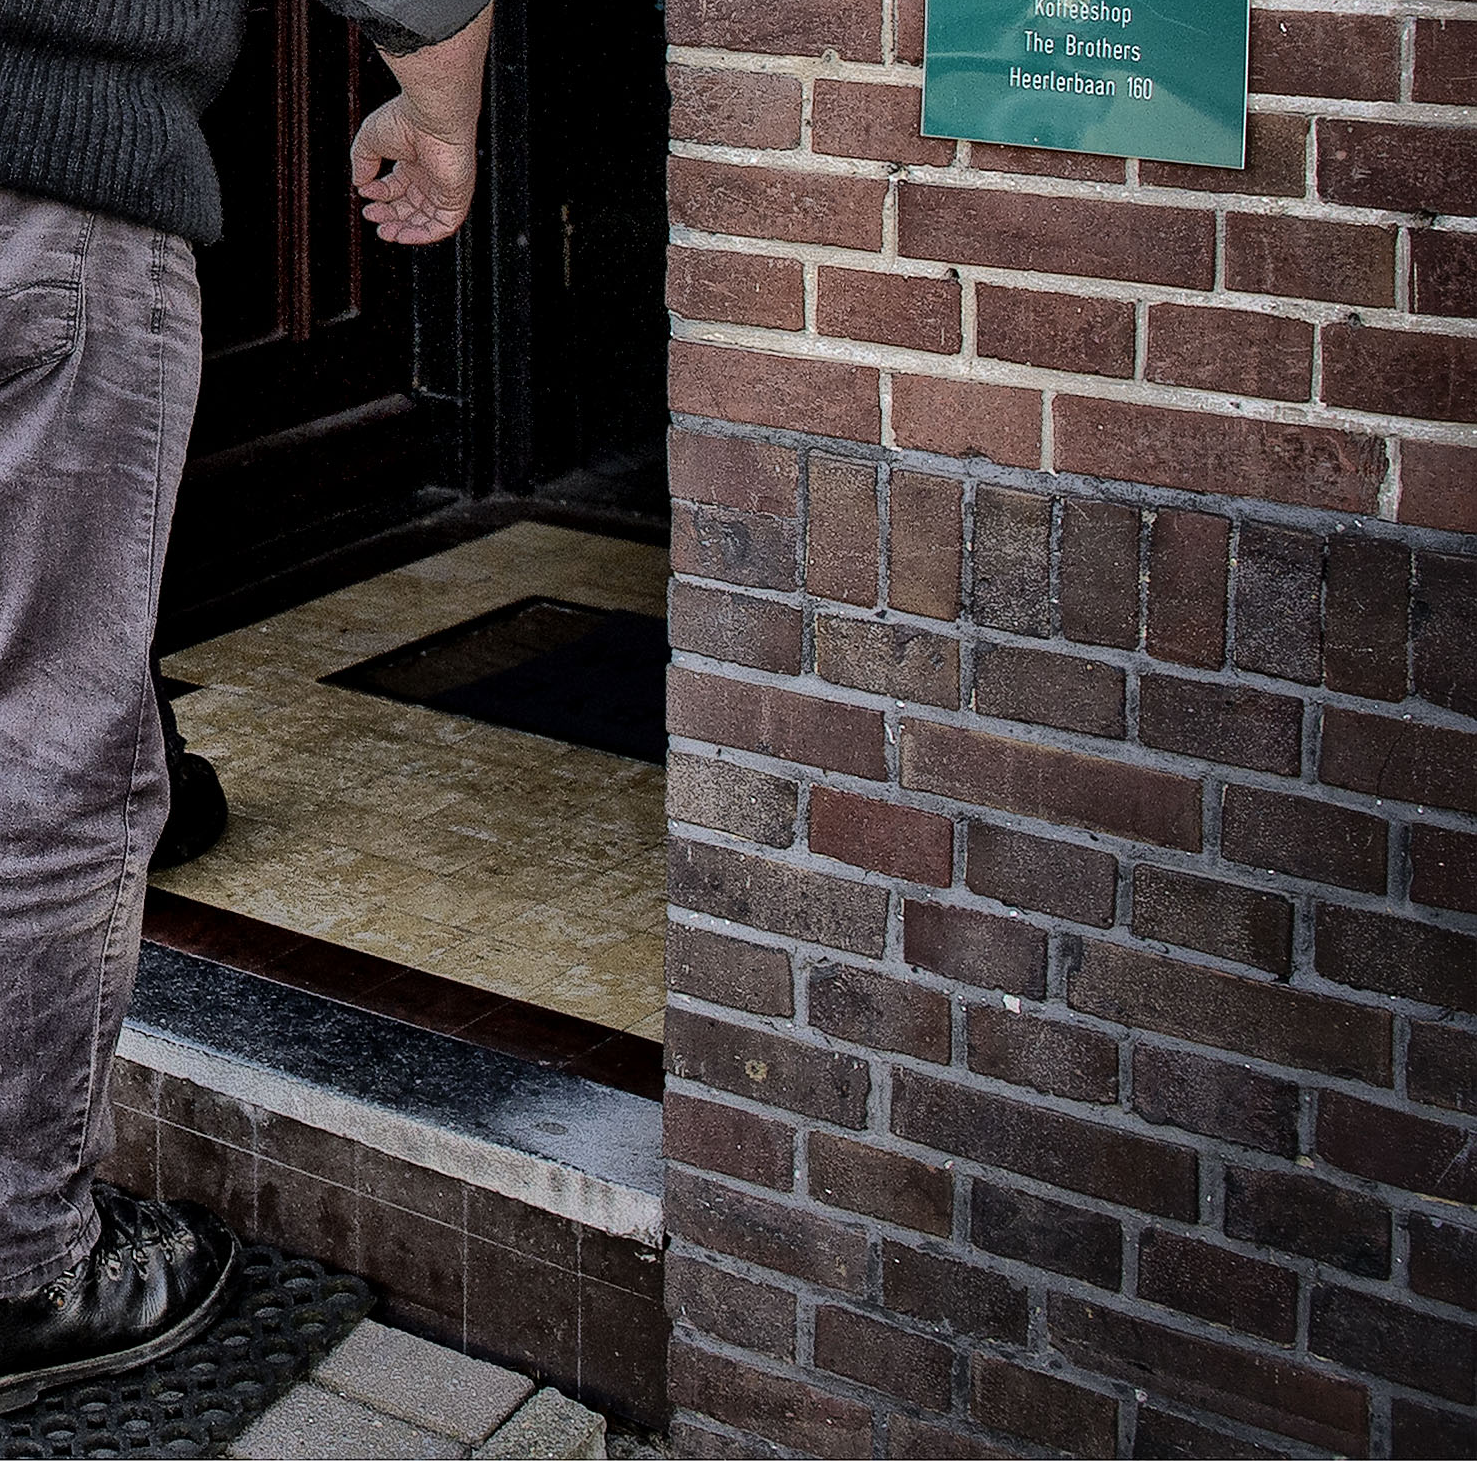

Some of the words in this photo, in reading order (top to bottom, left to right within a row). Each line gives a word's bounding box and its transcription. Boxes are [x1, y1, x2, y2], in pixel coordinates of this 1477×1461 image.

[1024, 30, 1054, 54] The
[1065, 34, 1142, 62] Brothers
[1009, 66, 1116, 97] Heerlerbaan
[1126, 76, 1153, 100] 160
